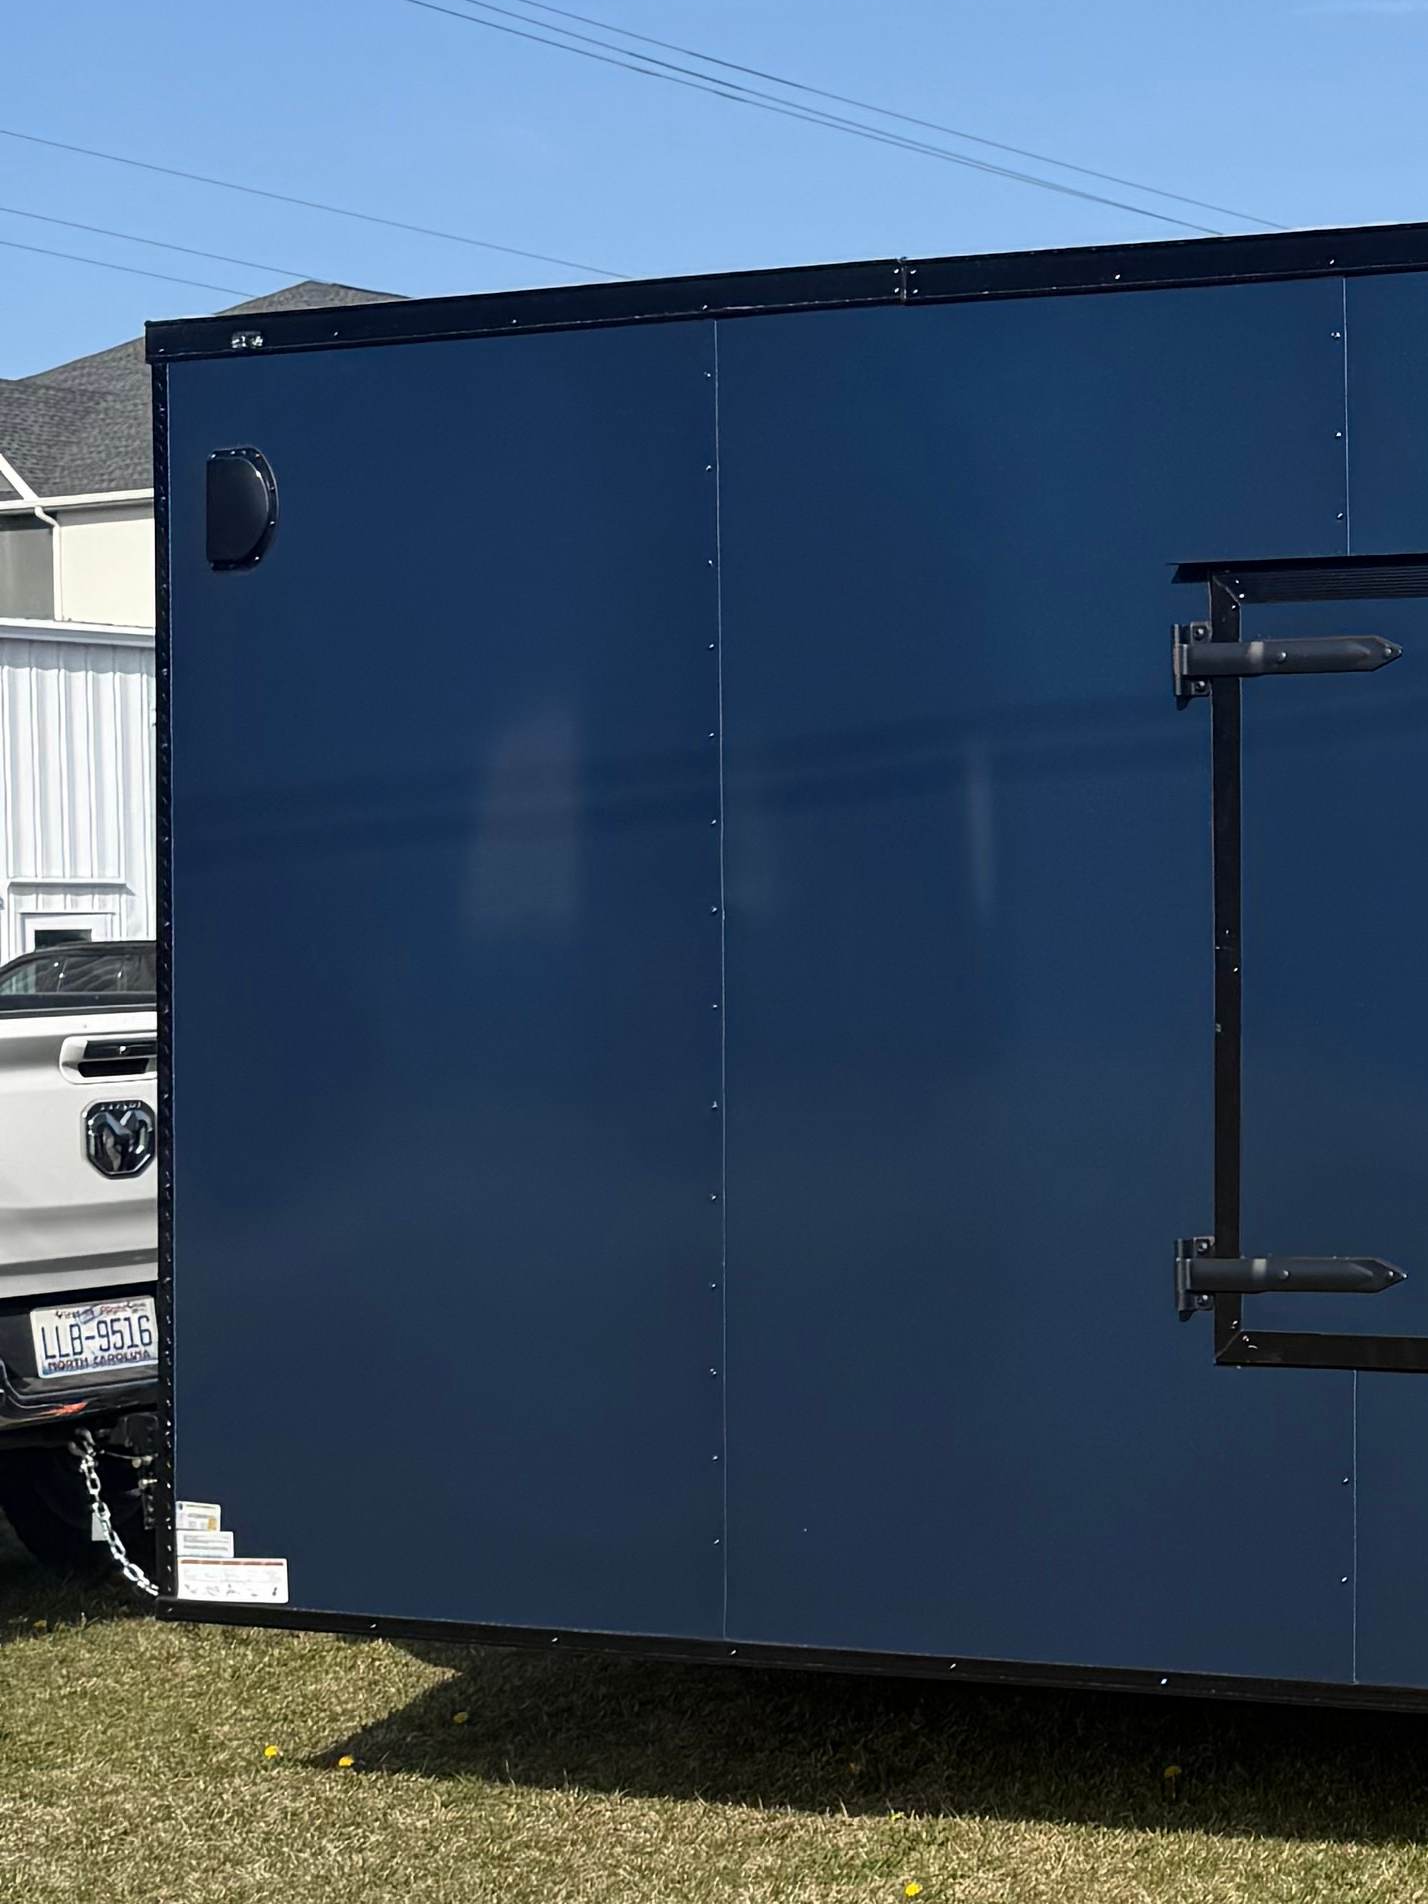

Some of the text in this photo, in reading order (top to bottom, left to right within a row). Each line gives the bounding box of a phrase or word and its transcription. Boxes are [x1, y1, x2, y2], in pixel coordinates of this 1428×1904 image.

[42, 1315, 152, 1359] LLB-9516
[48, 1350, 150, 1371] NORTH CAROLINA
